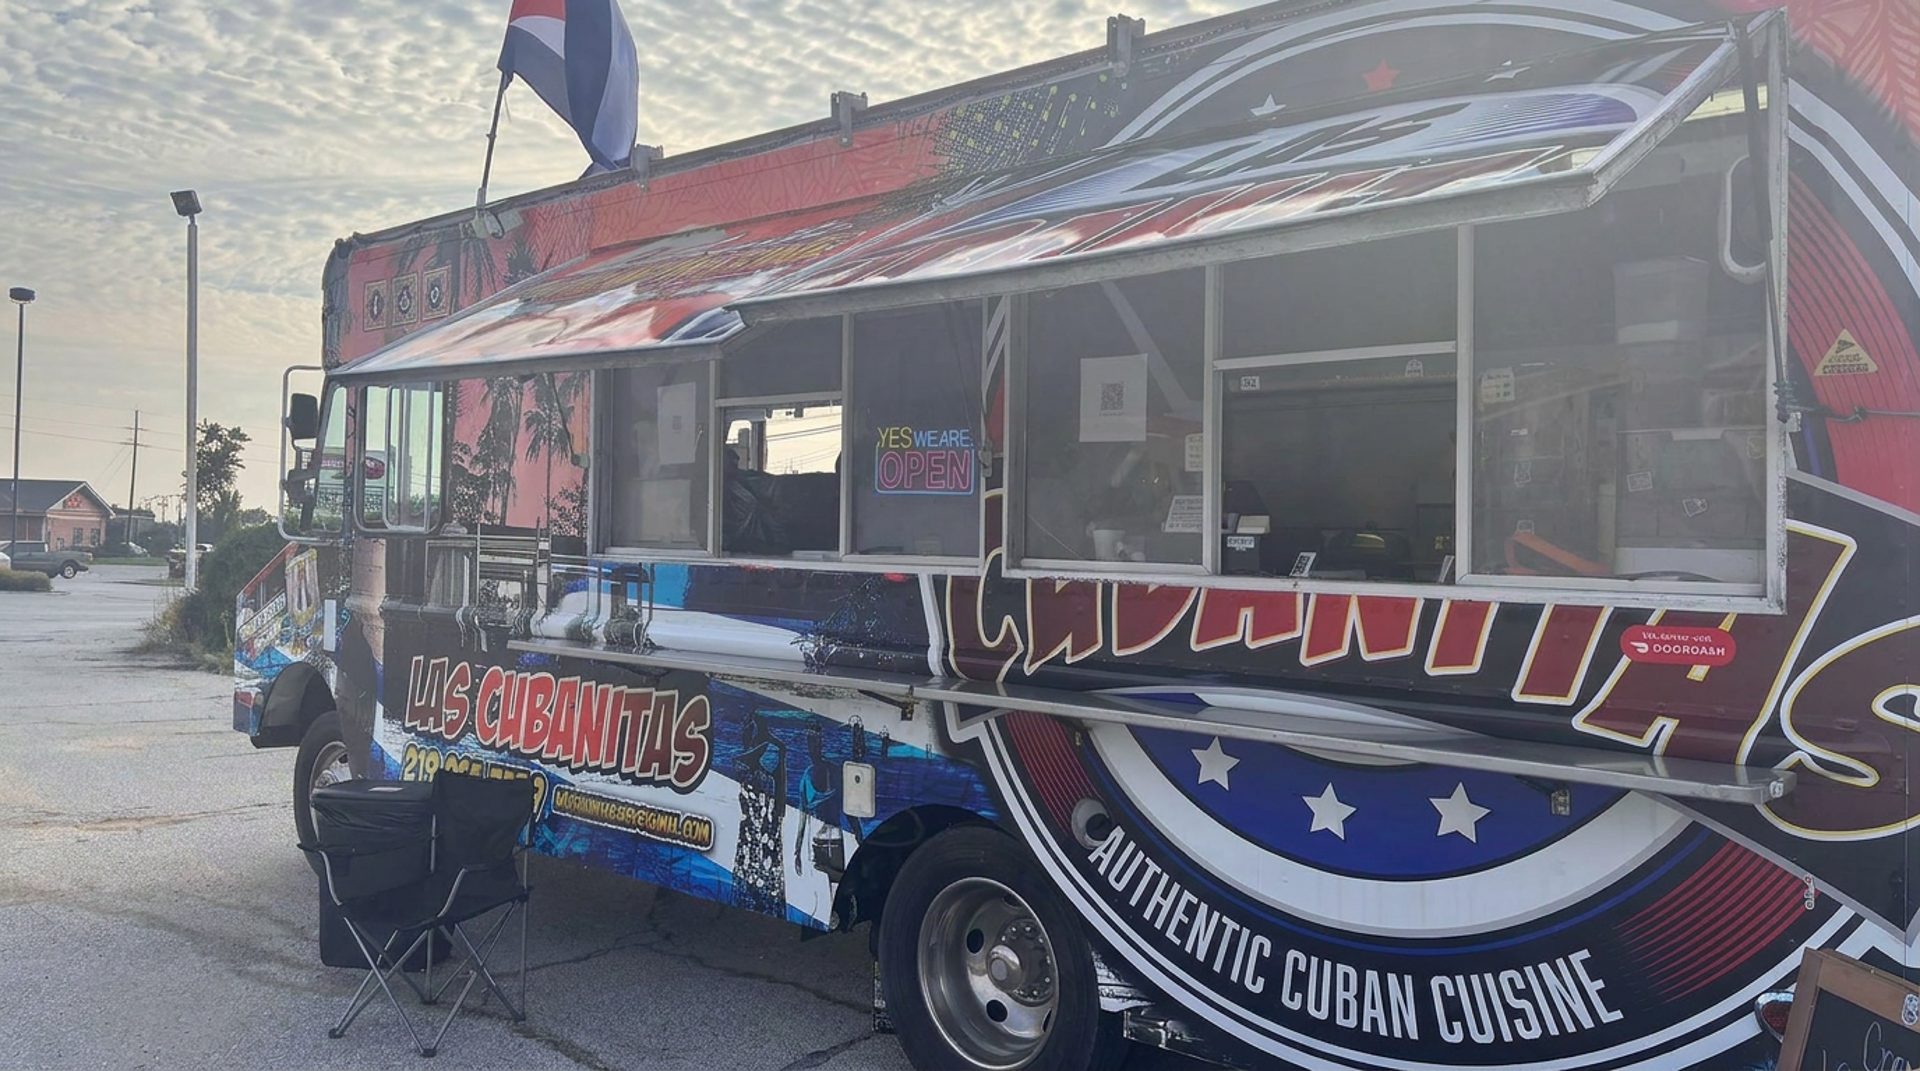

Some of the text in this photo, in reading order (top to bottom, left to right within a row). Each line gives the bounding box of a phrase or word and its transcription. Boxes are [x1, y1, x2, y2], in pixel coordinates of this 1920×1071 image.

[877, 426, 970, 449] YES WE ARE
[879, 450, 970, 490] OPEN
[405, 655, 471, 740] LAS
[475, 665, 711, 788] CUBANITAS
[1088, 825, 1624, 1044] AUTHENTIC CUBAN CUISINE
